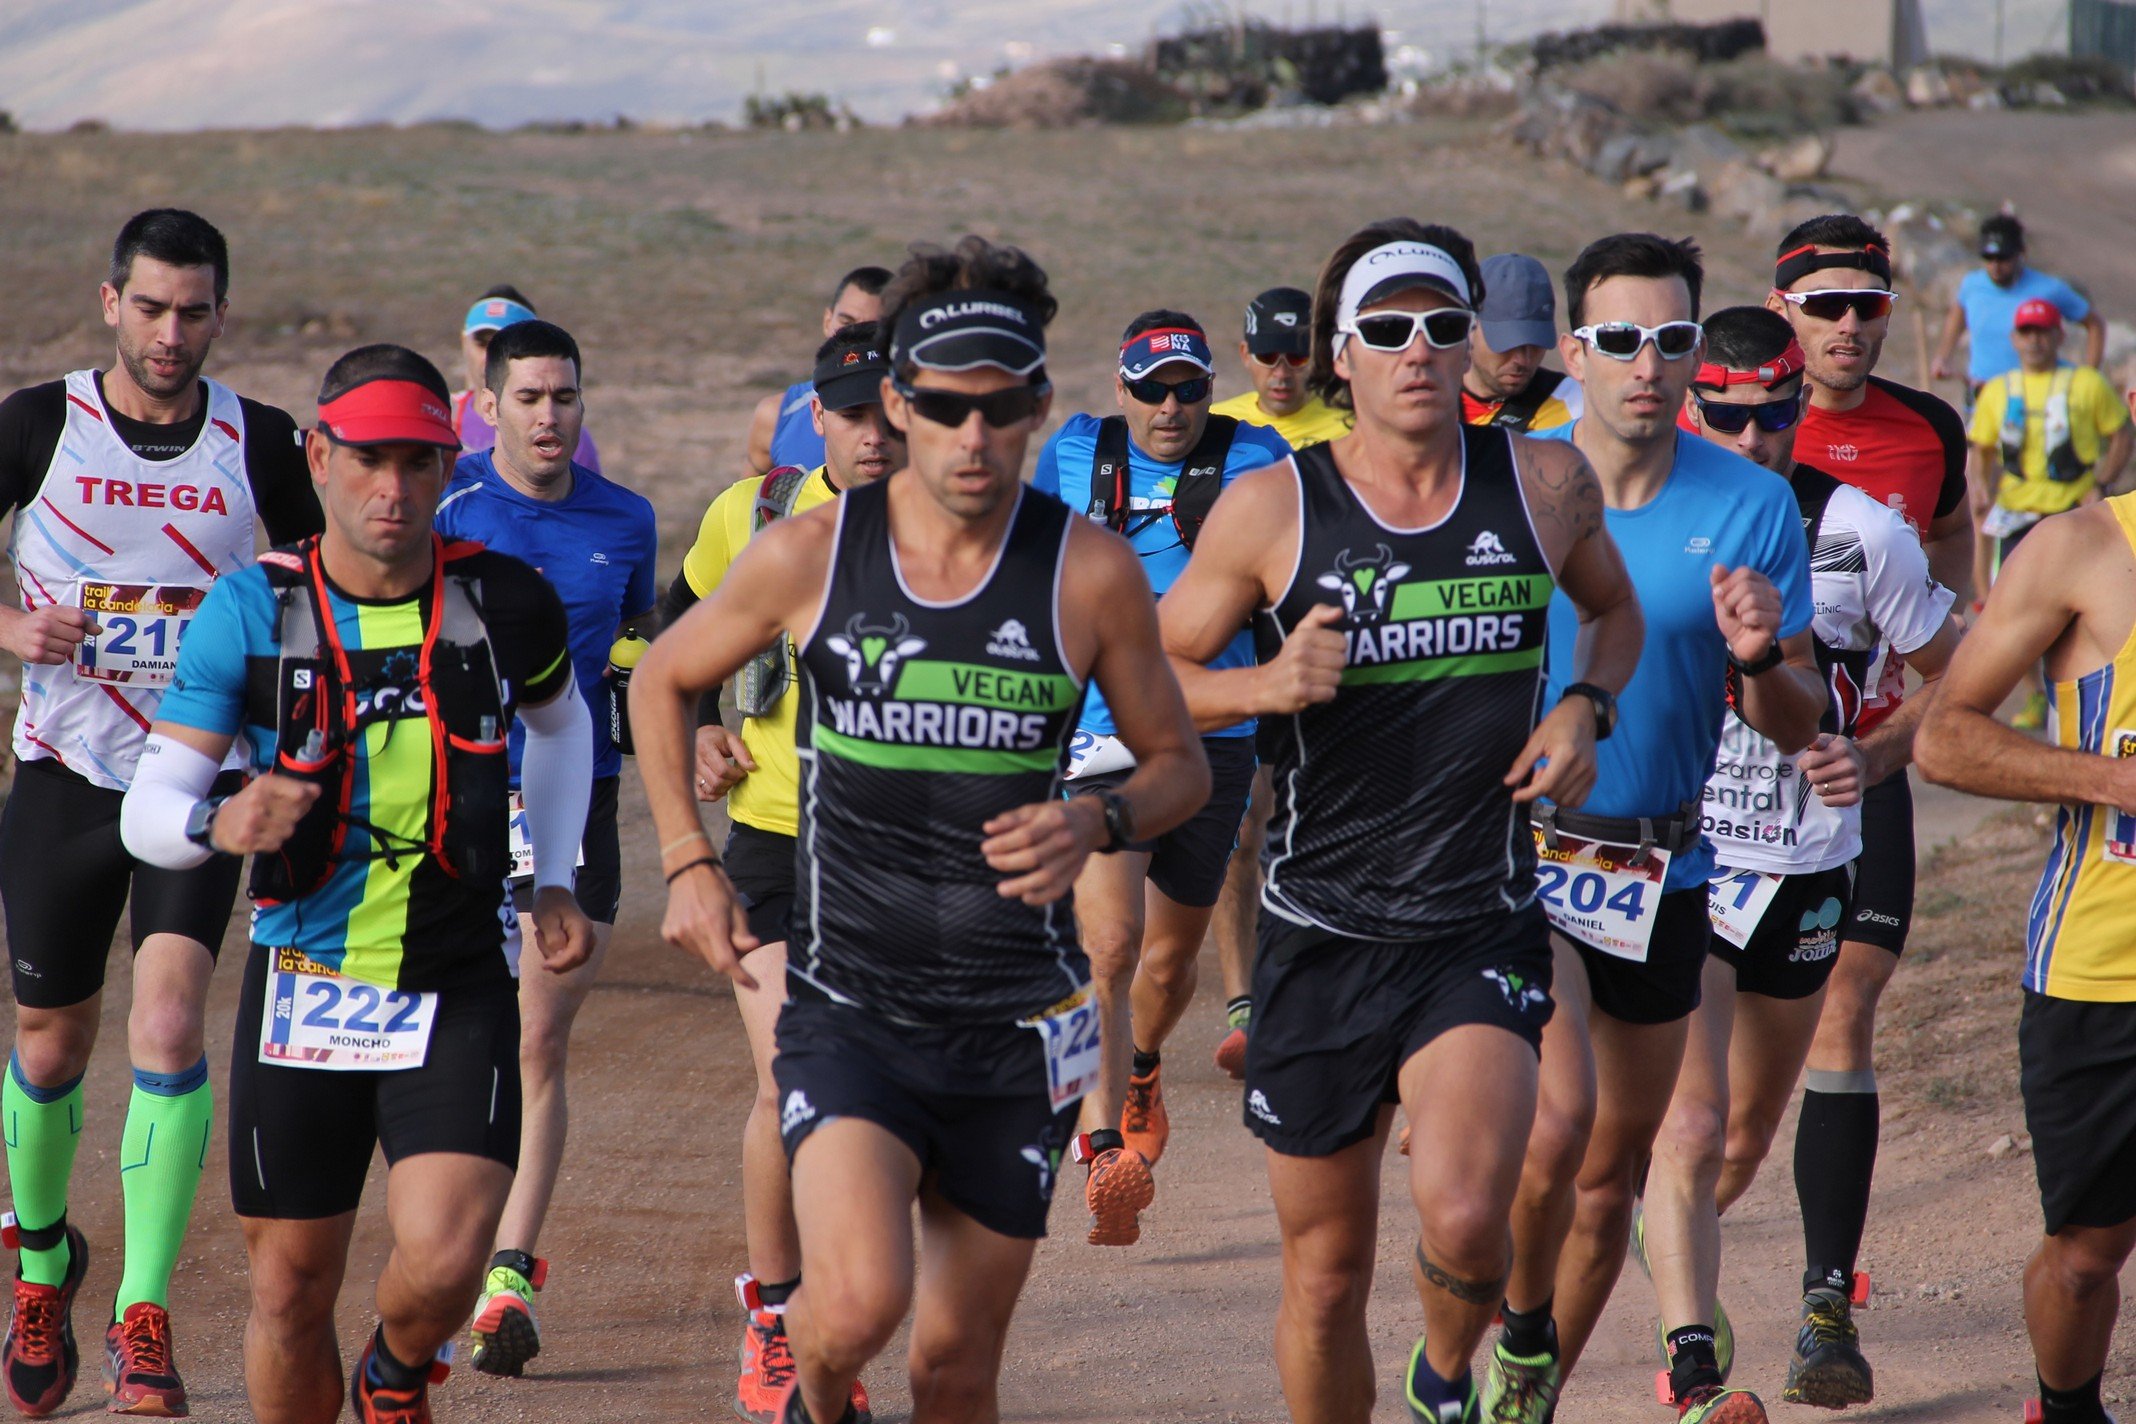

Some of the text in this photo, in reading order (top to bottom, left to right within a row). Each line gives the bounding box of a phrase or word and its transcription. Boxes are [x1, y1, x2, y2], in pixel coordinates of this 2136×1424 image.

[75, 476, 228, 516] TREGA
[84, 585, 112, 598] trail
[1437, 579, 1531, 610] VEGAN
[83, 598, 174, 613] la candelaria
[84, 632, 96, 647] 20
[953, 668, 1056, 706] VEGAN
[827, 695, 1047, 748] WARRIORS
[1535, 864, 1646, 922] 204
[1871, 913, 1900, 926] asics
[278, 956, 293, 970] la
[301, 981, 422, 1033] 222
[329, 1034, 391, 1049] MONCHO
